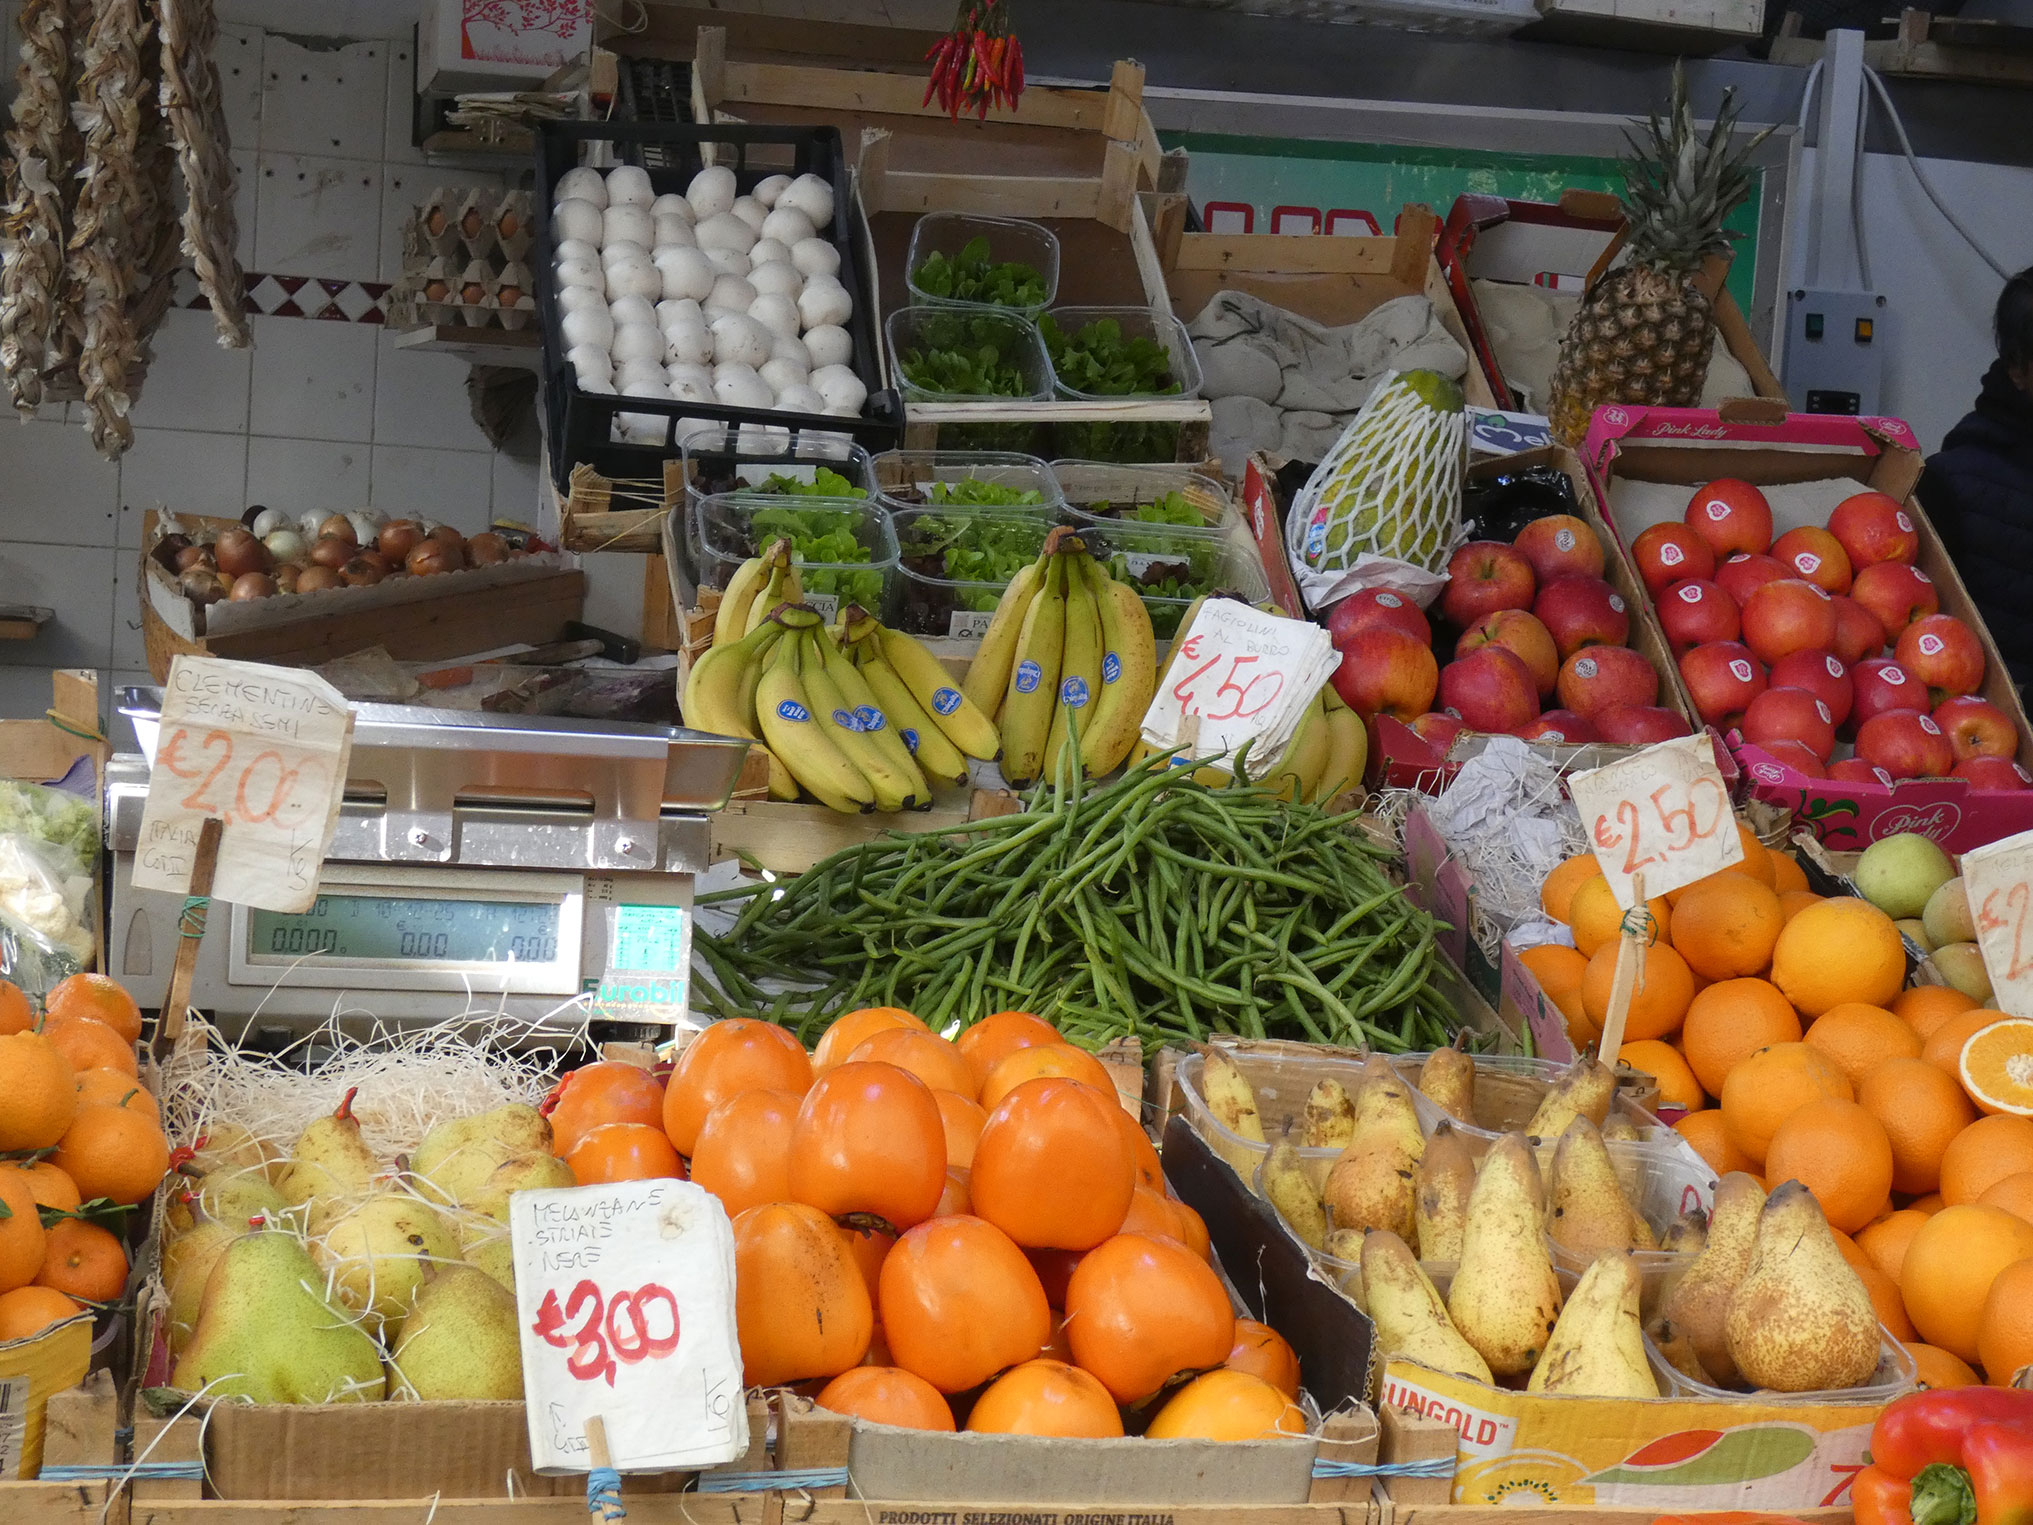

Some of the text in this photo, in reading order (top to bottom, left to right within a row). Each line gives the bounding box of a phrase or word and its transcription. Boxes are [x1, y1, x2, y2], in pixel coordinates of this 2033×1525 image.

[1652, 422, 1728, 439] Pink Lady
[1246, 640, 1291, 657] BURRO
[1594, 776, 1726, 875] €2,50
[1882, 807, 1945, 835] Pink
[583, 978, 685, 1003] Eurobil
[878, 1511, 1175, 1525] PRODOTTI SELEZIONATI ORIGINE ITALIA
